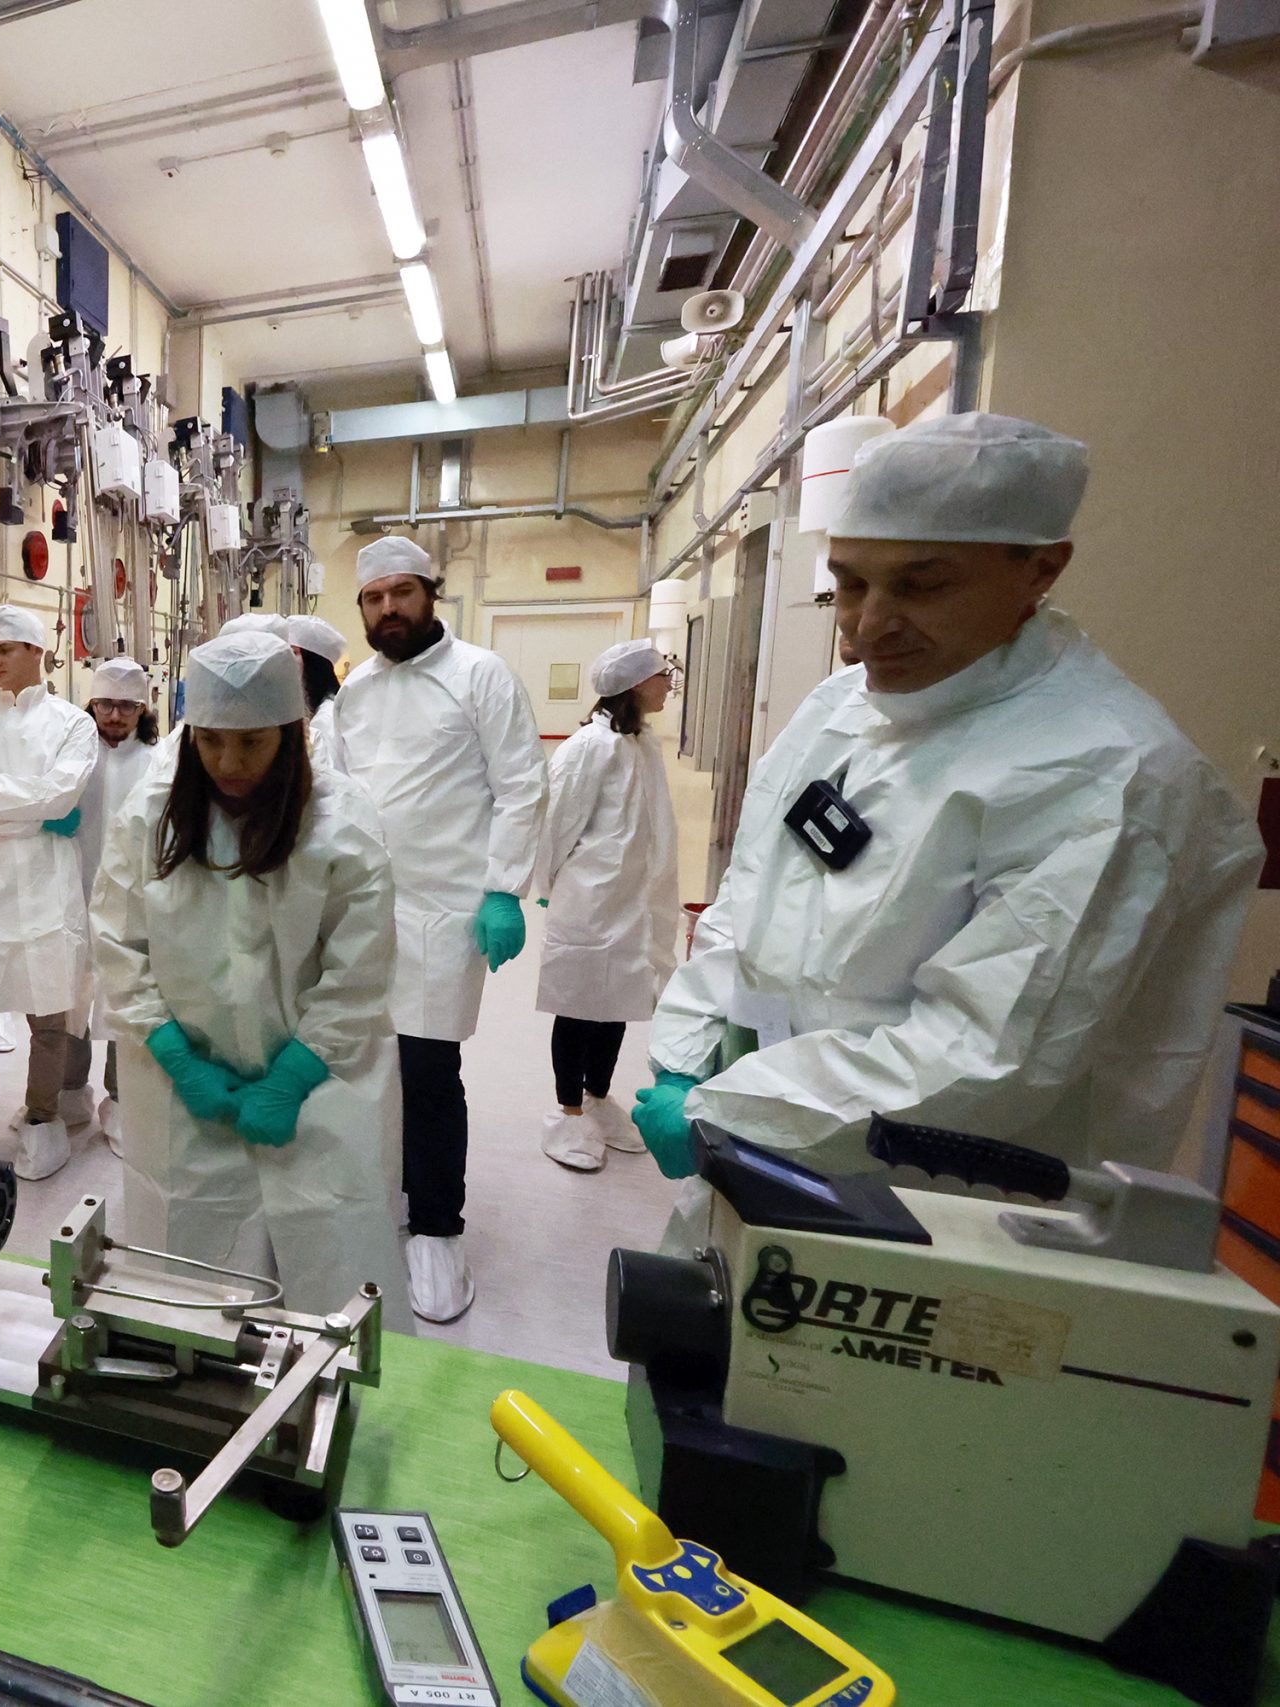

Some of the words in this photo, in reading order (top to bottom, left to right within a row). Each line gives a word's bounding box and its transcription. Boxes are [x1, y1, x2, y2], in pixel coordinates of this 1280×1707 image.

[765, 1273, 941, 1337] ORTE
[440, 1674, 478, 1684] Thermo
[410, 1689, 418, 1697] A
[426, 1690, 450, 1699] 005
[458, 1692, 476, 1701] RT
